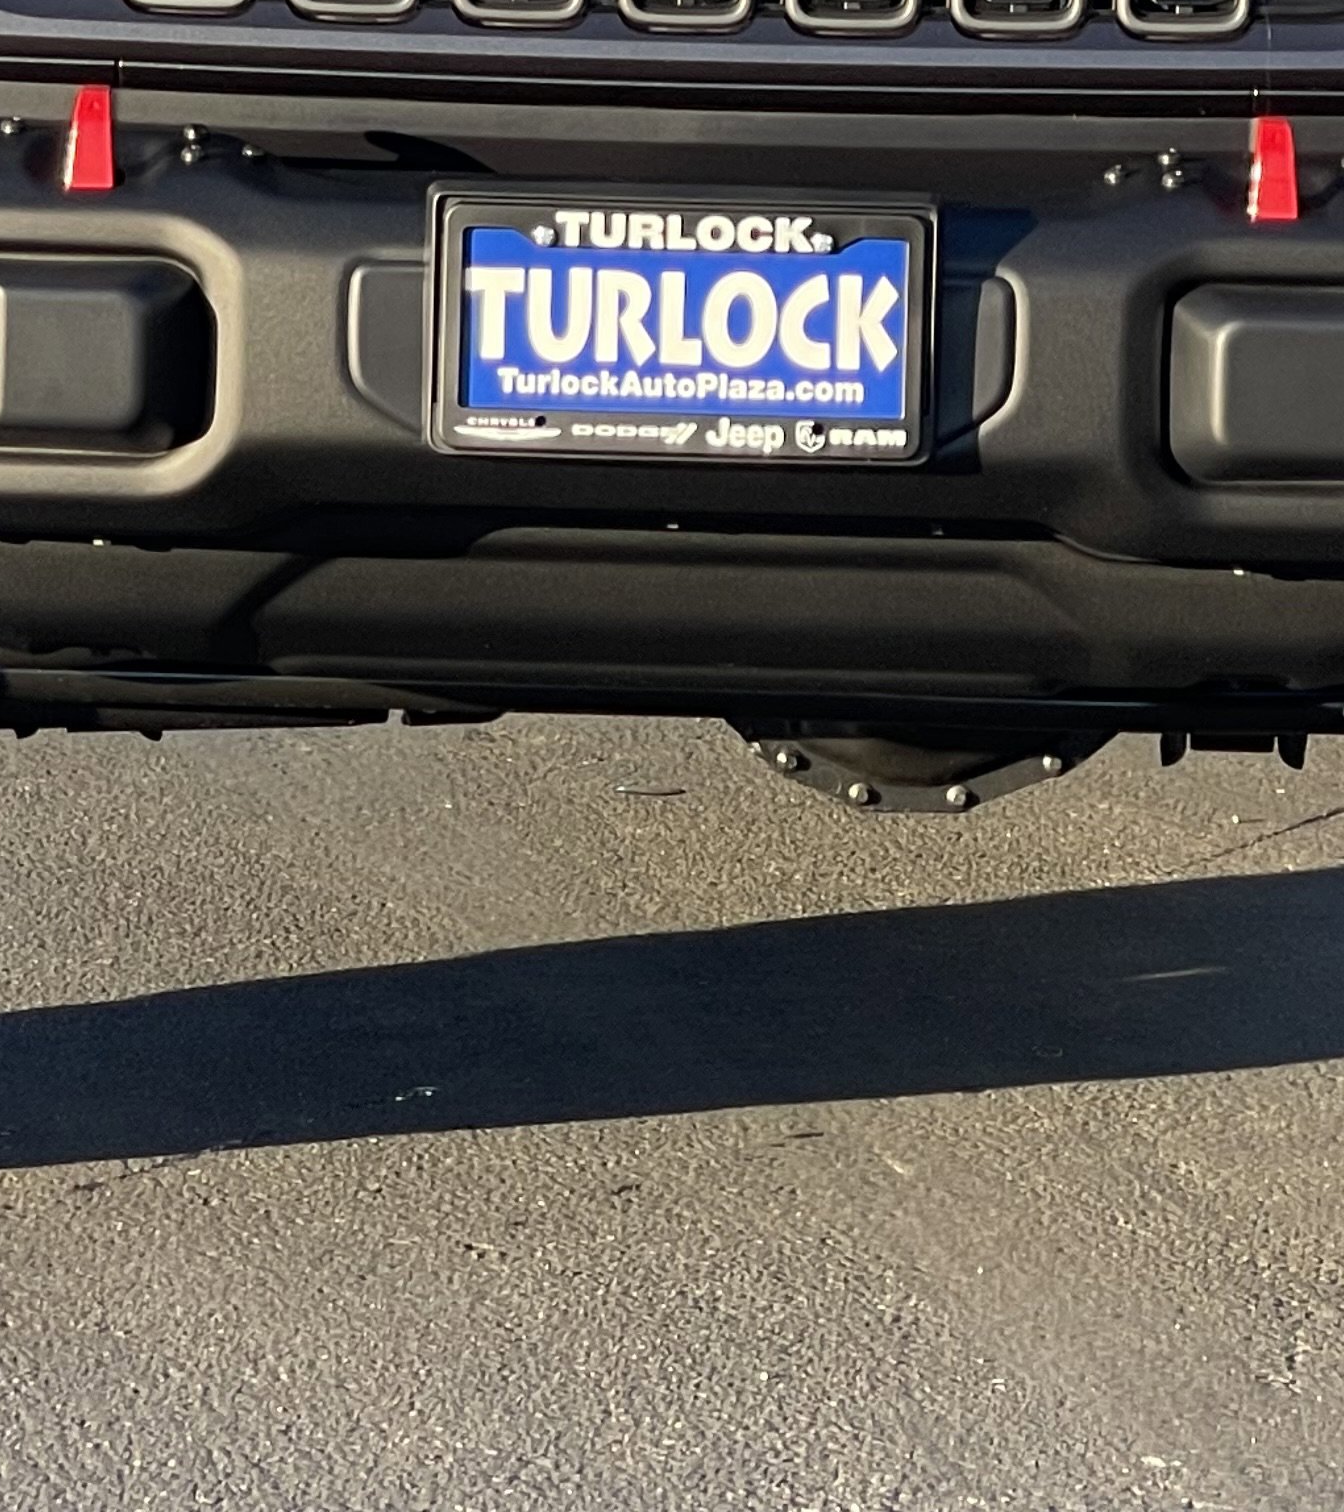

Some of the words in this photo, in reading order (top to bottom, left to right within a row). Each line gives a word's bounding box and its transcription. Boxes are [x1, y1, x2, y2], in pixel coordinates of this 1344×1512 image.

[554, 211, 817, 253] TURLOCK
[465, 266, 900, 372] TURLOCK
[496, 366, 865, 403] TurlockAutoPlaza.com
[705, 416, 785, 455] Jeep
[829, 428, 907, 447] RAM
